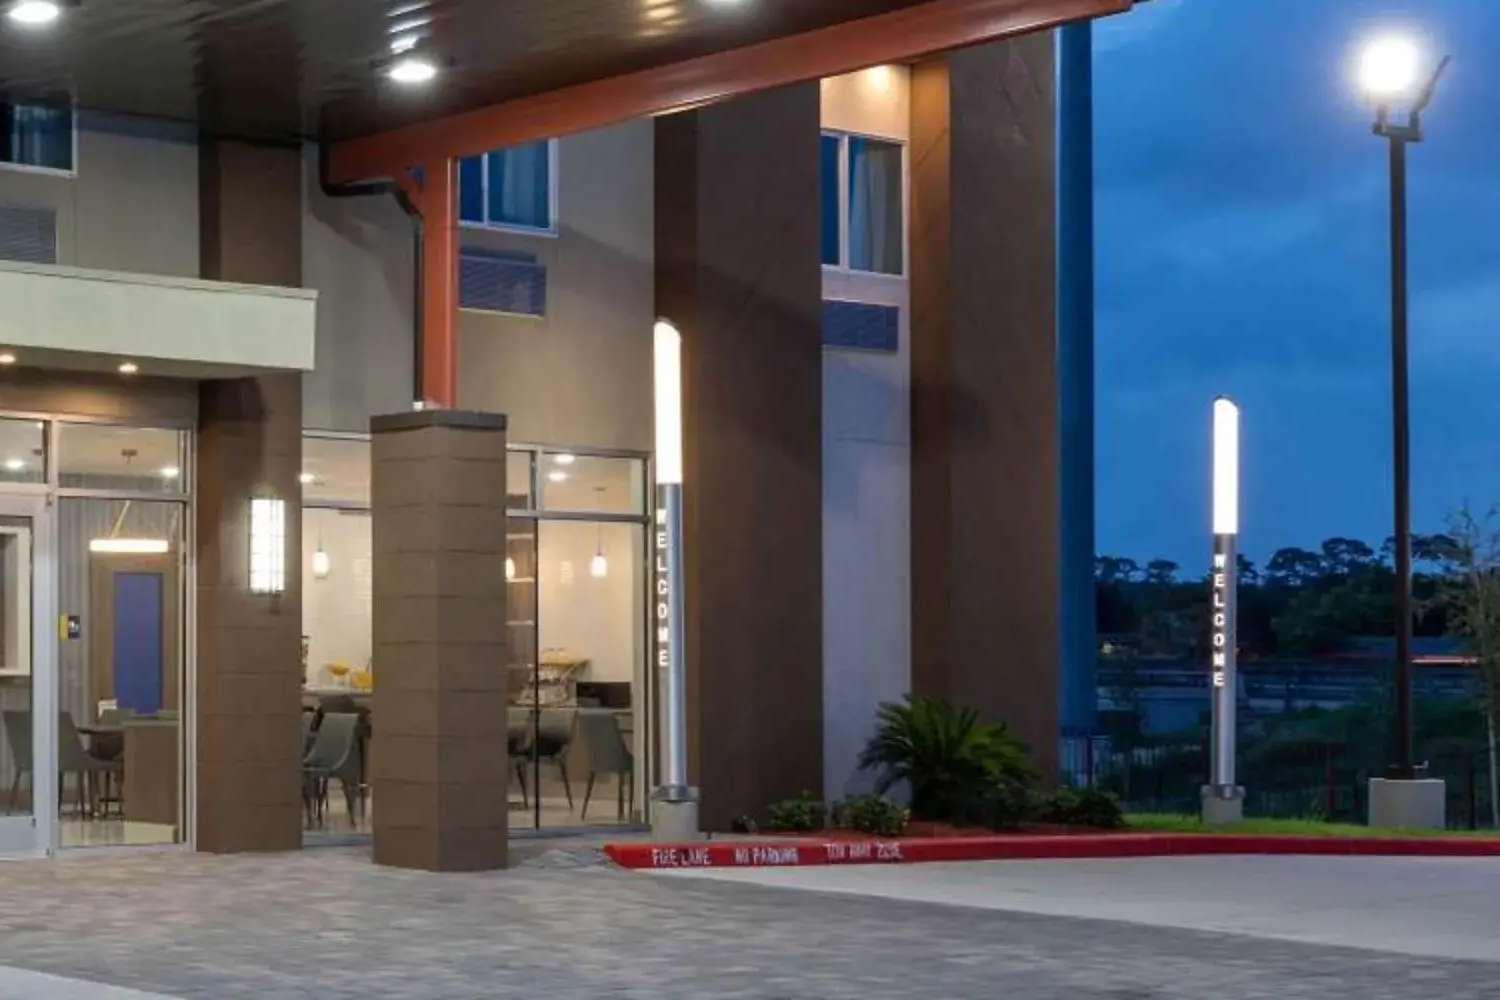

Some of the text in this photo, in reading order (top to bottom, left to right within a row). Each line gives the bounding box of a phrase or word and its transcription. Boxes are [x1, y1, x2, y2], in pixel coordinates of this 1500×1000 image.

[655, 508, 668, 667] WELCOME
[1213, 554, 1225, 687] WELCOME
[652, 848, 711, 867] FIRE LANE
